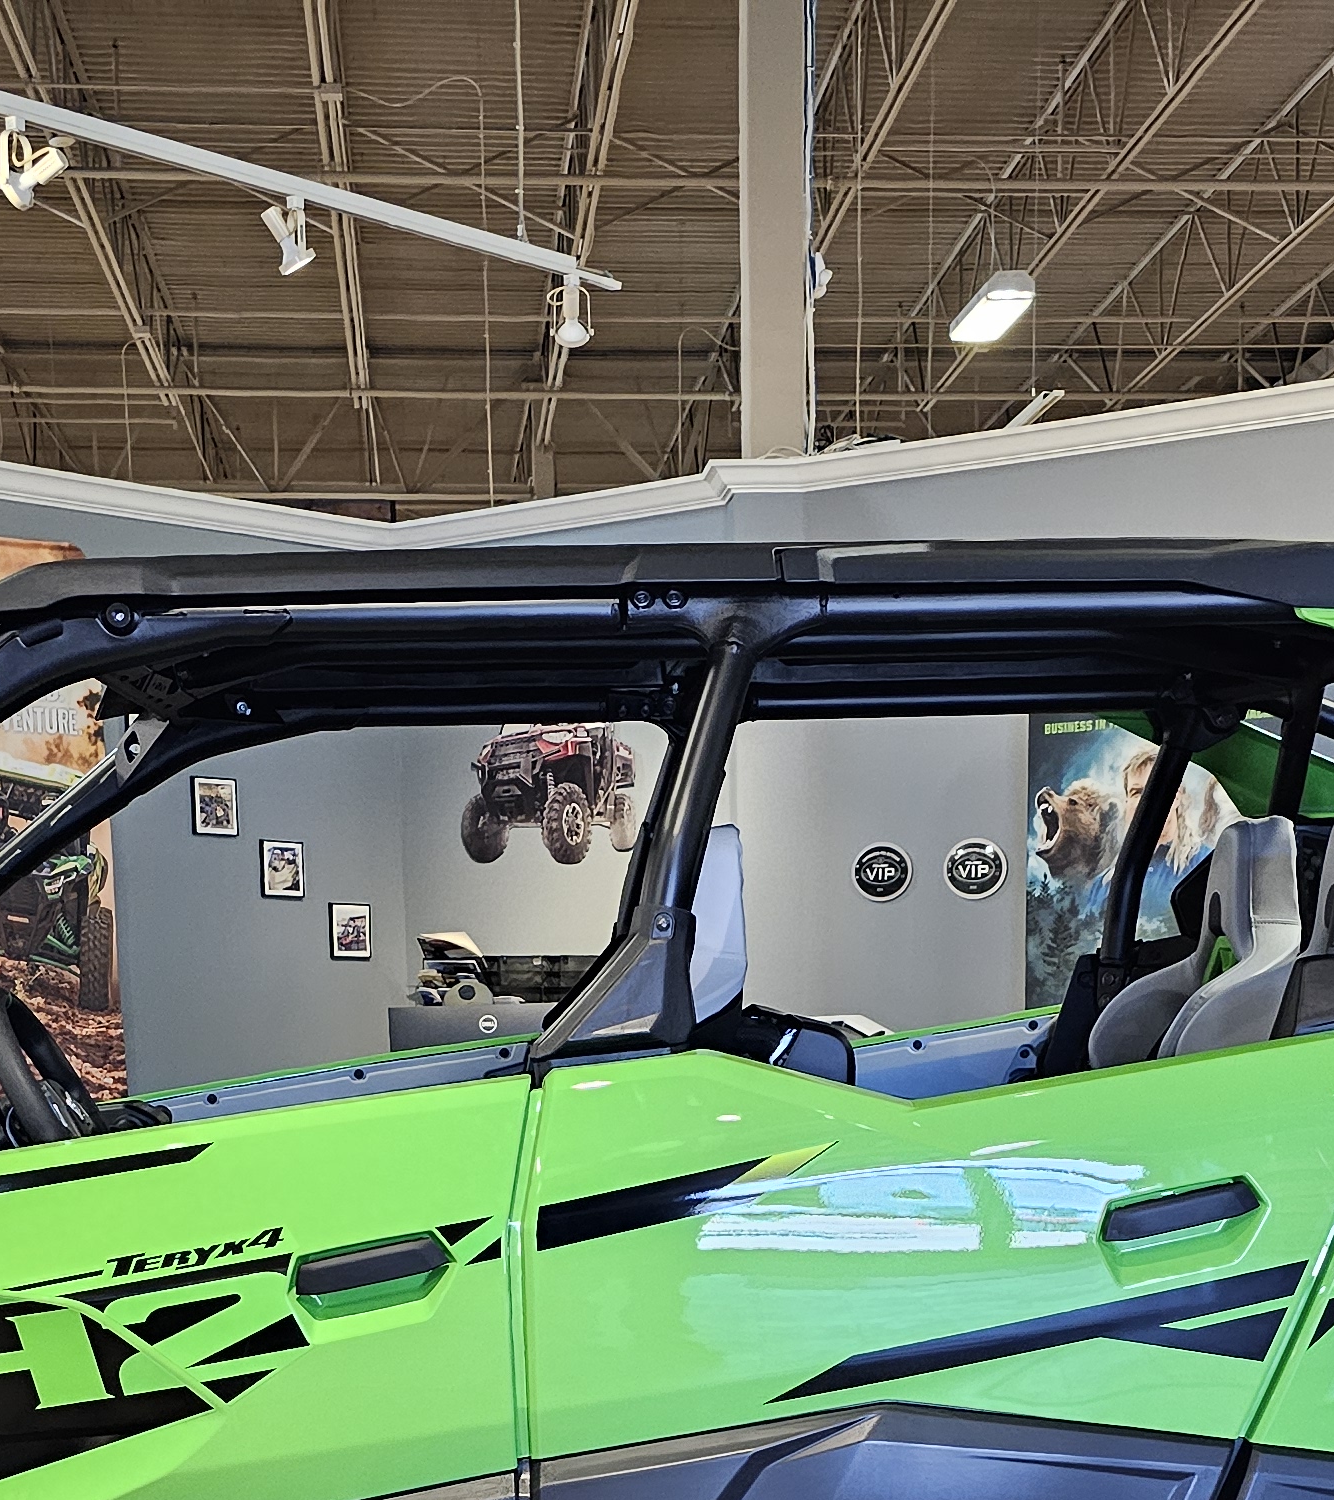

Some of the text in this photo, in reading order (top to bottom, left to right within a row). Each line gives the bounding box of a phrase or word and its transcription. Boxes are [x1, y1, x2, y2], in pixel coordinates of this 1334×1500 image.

[1044, 720, 1093, 735] BUSINESS
[866, 867, 896, 881] VIP
[958, 864, 990, 878] VIP
